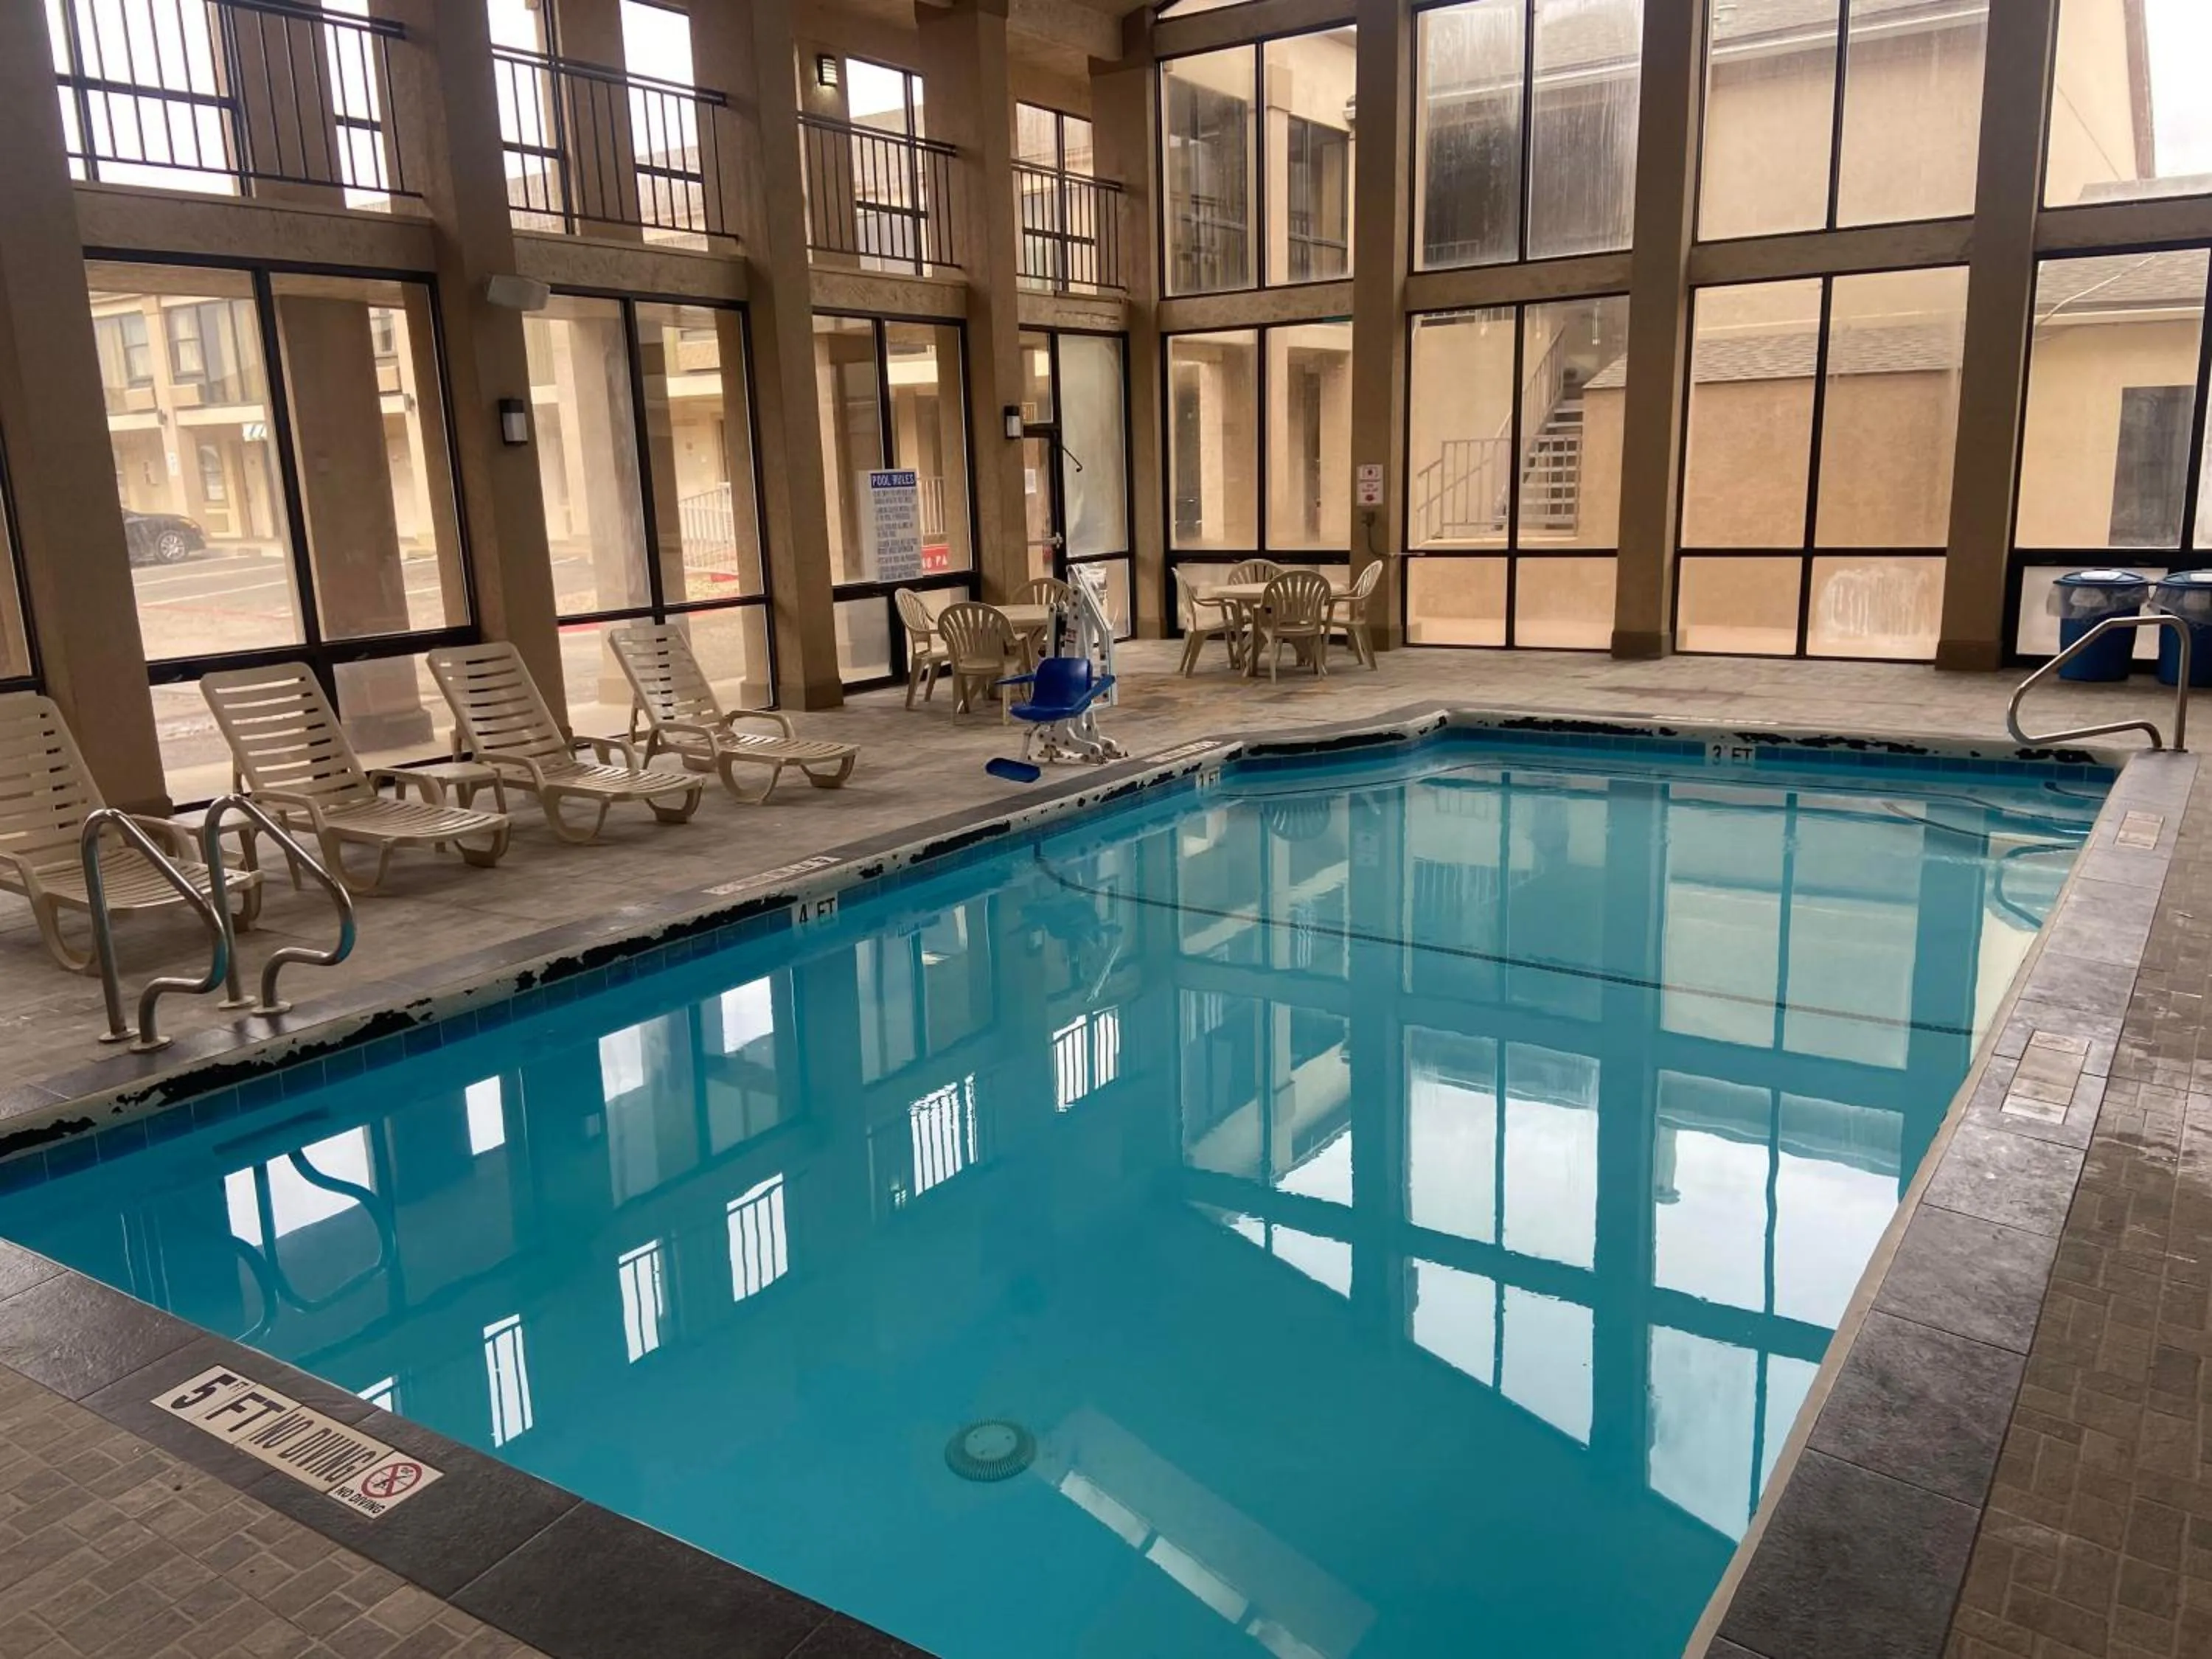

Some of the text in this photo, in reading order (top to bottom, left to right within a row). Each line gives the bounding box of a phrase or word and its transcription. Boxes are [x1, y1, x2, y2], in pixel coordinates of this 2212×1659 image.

[872, 473, 914, 486] POOL RULES
[1732, 747, 1753, 760] FT
[817, 897, 835, 917] FT
[170, 1374, 377, 1482] 5 FT NO DIVING
[335, 1486, 385, 1514] NO DIVING
